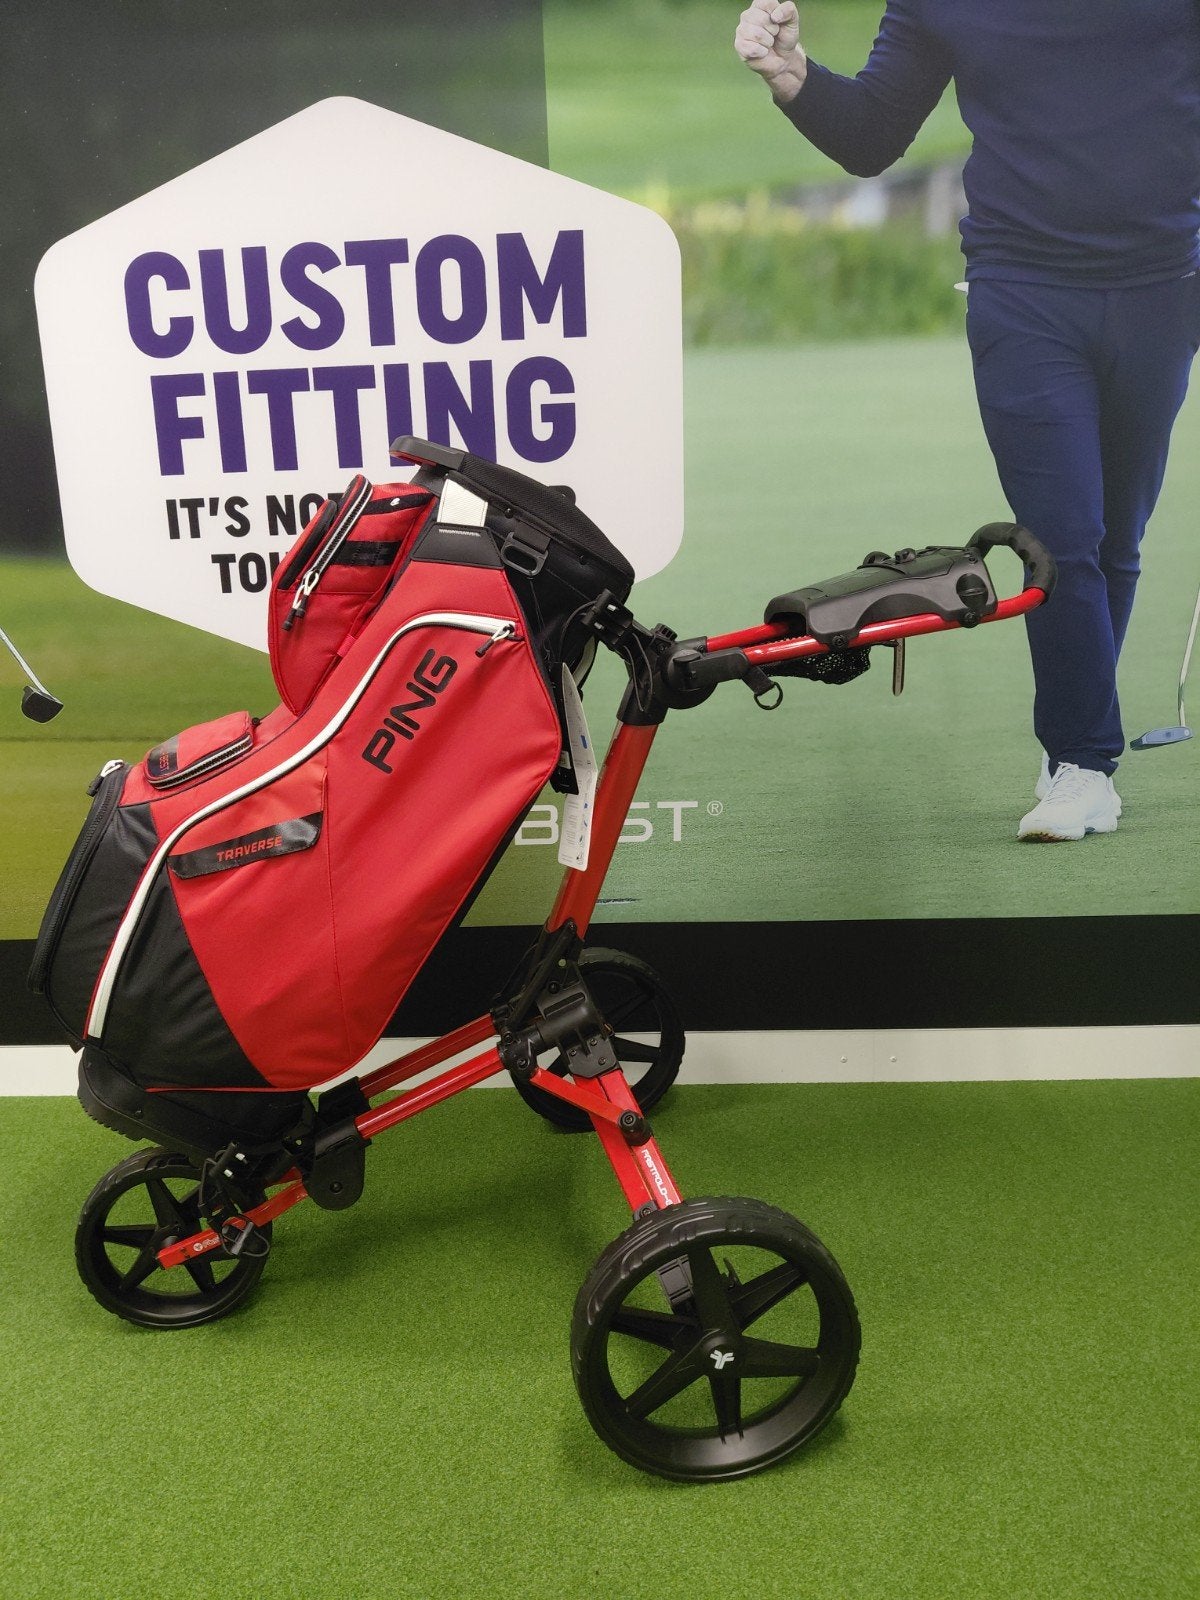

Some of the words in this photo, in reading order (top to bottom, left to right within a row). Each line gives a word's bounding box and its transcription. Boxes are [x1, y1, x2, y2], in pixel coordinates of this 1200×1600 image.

[124, 229, 587, 359] CUSTOM
[150, 356, 577, 476] FITTING
[166, 496, 250, 539] IT'S
[362, 648, 458, 774] PING
[217, 834, 283, 863] TRAVERSE
